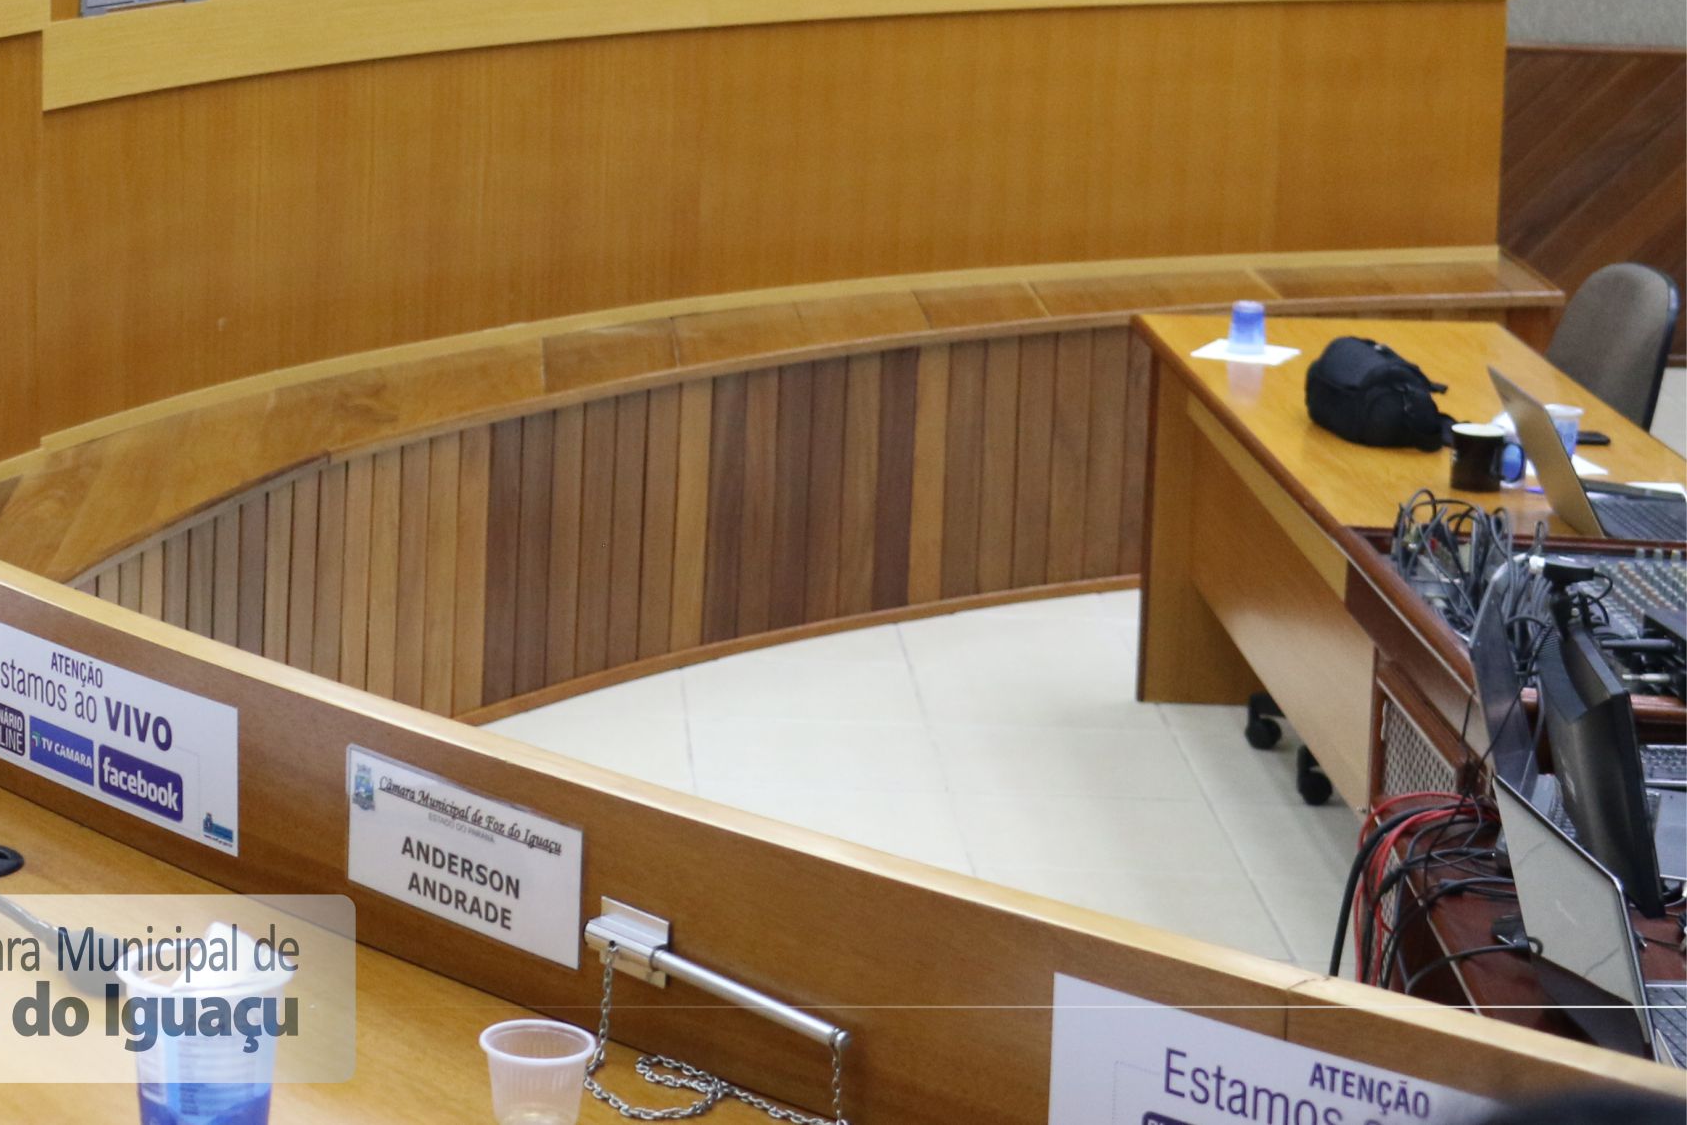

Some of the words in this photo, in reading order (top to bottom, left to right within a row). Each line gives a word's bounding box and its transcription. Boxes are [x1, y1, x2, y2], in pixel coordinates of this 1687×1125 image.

[51, 651, 103, 689] ATENÇÃO
[41, 737, 53, 752] TV
[74, 690, 98, 724] ao
[104, 695, 173, 752] VIVO
[102, 756, 179, 812] facebook
[379, 776, 415, 803] Câmara
[417, 790, 472, 823] Municipal
[472, 808, 483, 826] de
[485, 815, 506, 835] Foz
[507, 823, 521, 840] do
[524, 829, 562, 857] Iguaçu
[401, 836, 521, 900] ANDERSON
[408, 871, 512, 931] ANDRADE
[1163, 1047, 1344, 1125] Estamos
[1309, 1062, 1430, 1120] ATENÇÃO
